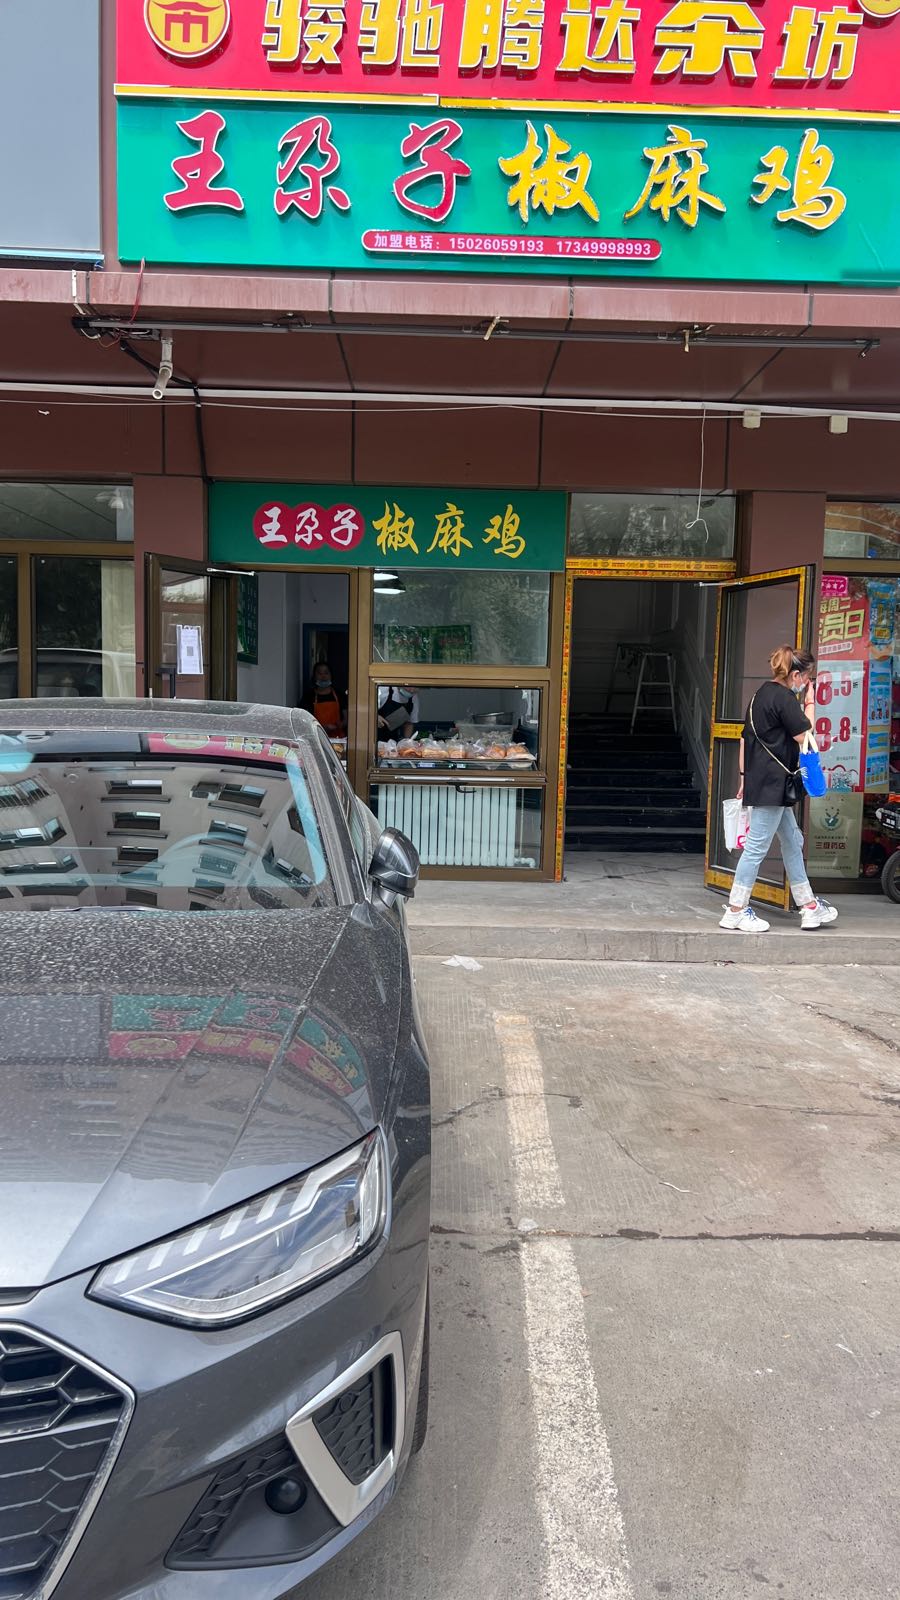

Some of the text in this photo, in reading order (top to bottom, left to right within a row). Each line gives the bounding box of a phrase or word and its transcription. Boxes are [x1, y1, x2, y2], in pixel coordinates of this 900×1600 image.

[449, 237, 544, 252] 15026059193
[556, 240, 652, 256] 17349998993
[818, 609, 865, 643] 员日
